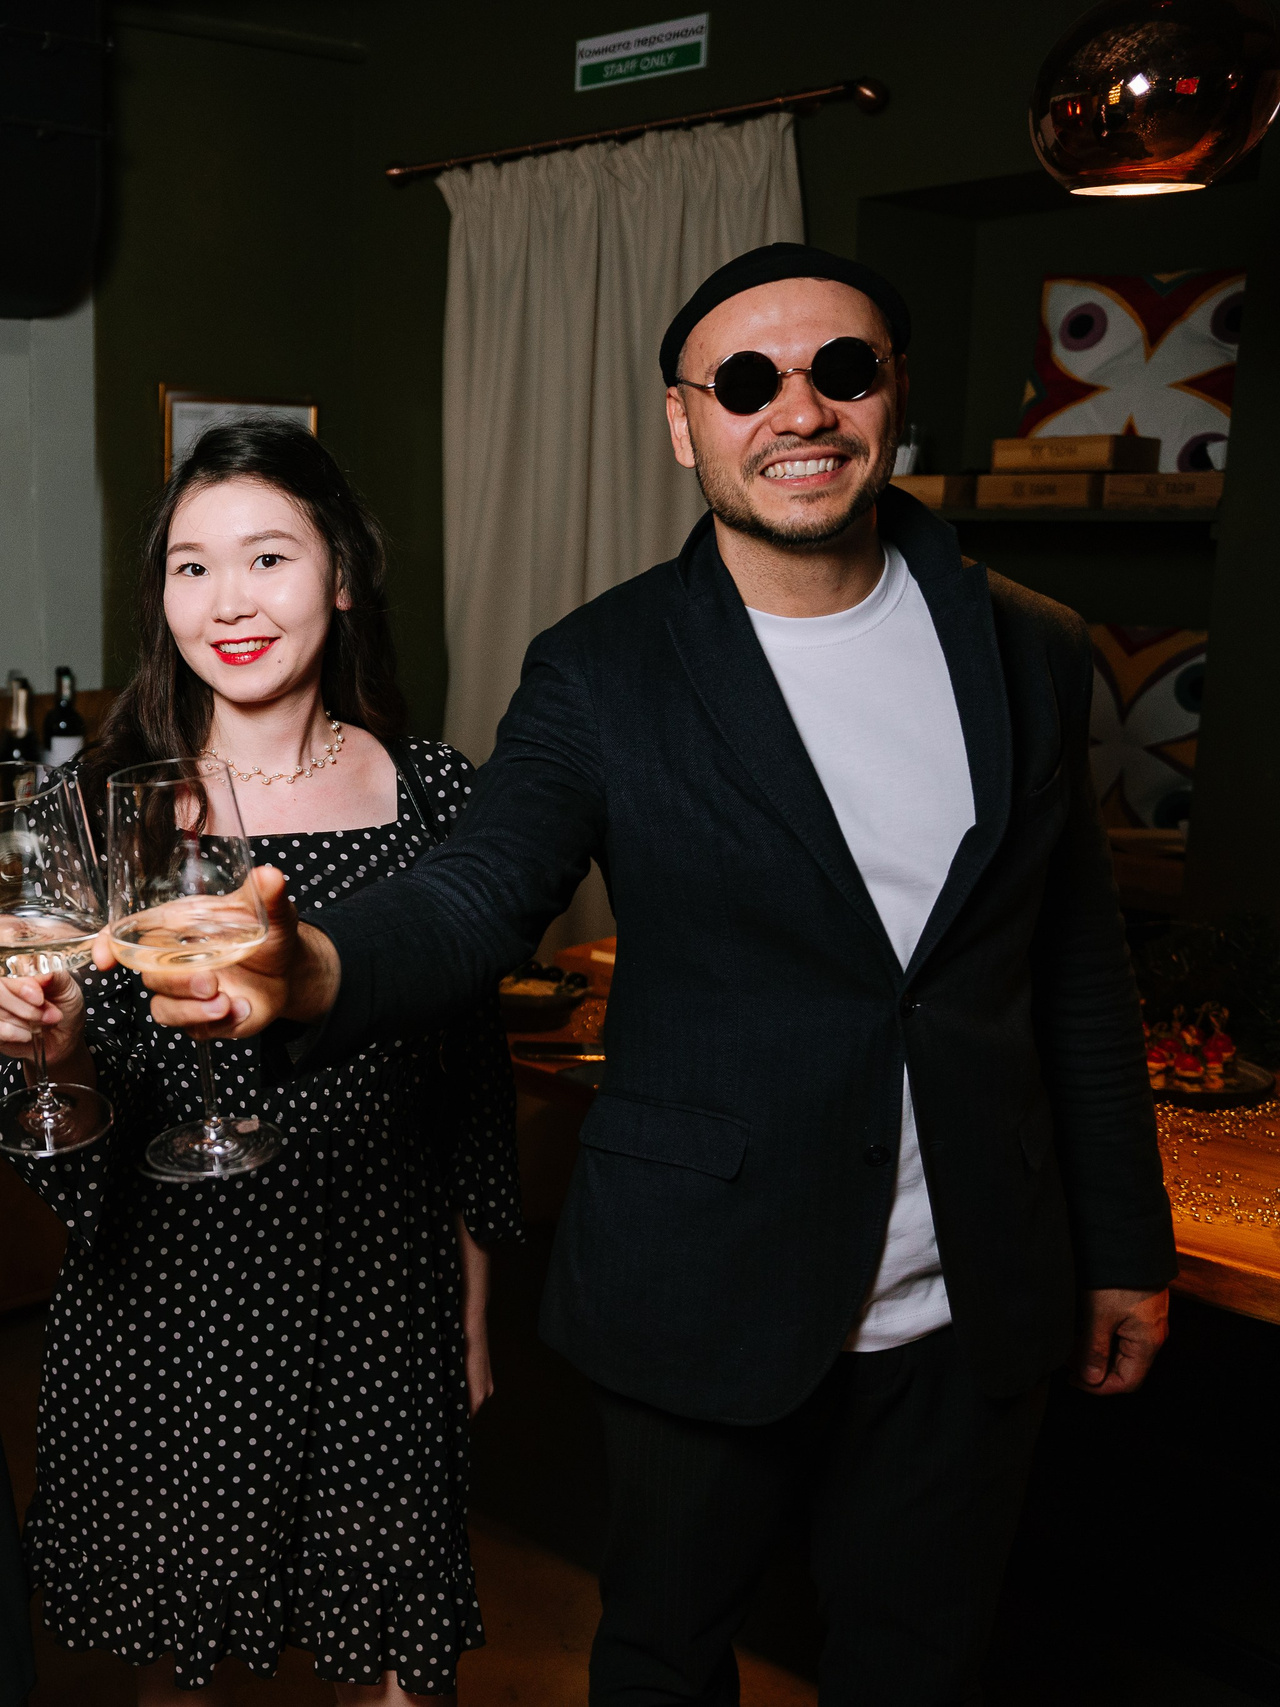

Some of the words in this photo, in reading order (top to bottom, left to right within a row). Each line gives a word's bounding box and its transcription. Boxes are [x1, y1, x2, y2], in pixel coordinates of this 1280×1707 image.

[578, 40, 631, 59] Комната
[634, 25, 705, 48] персонала
[603, 58, 638, 78] STAFF
[639, 51, 677, 71] ONLY
